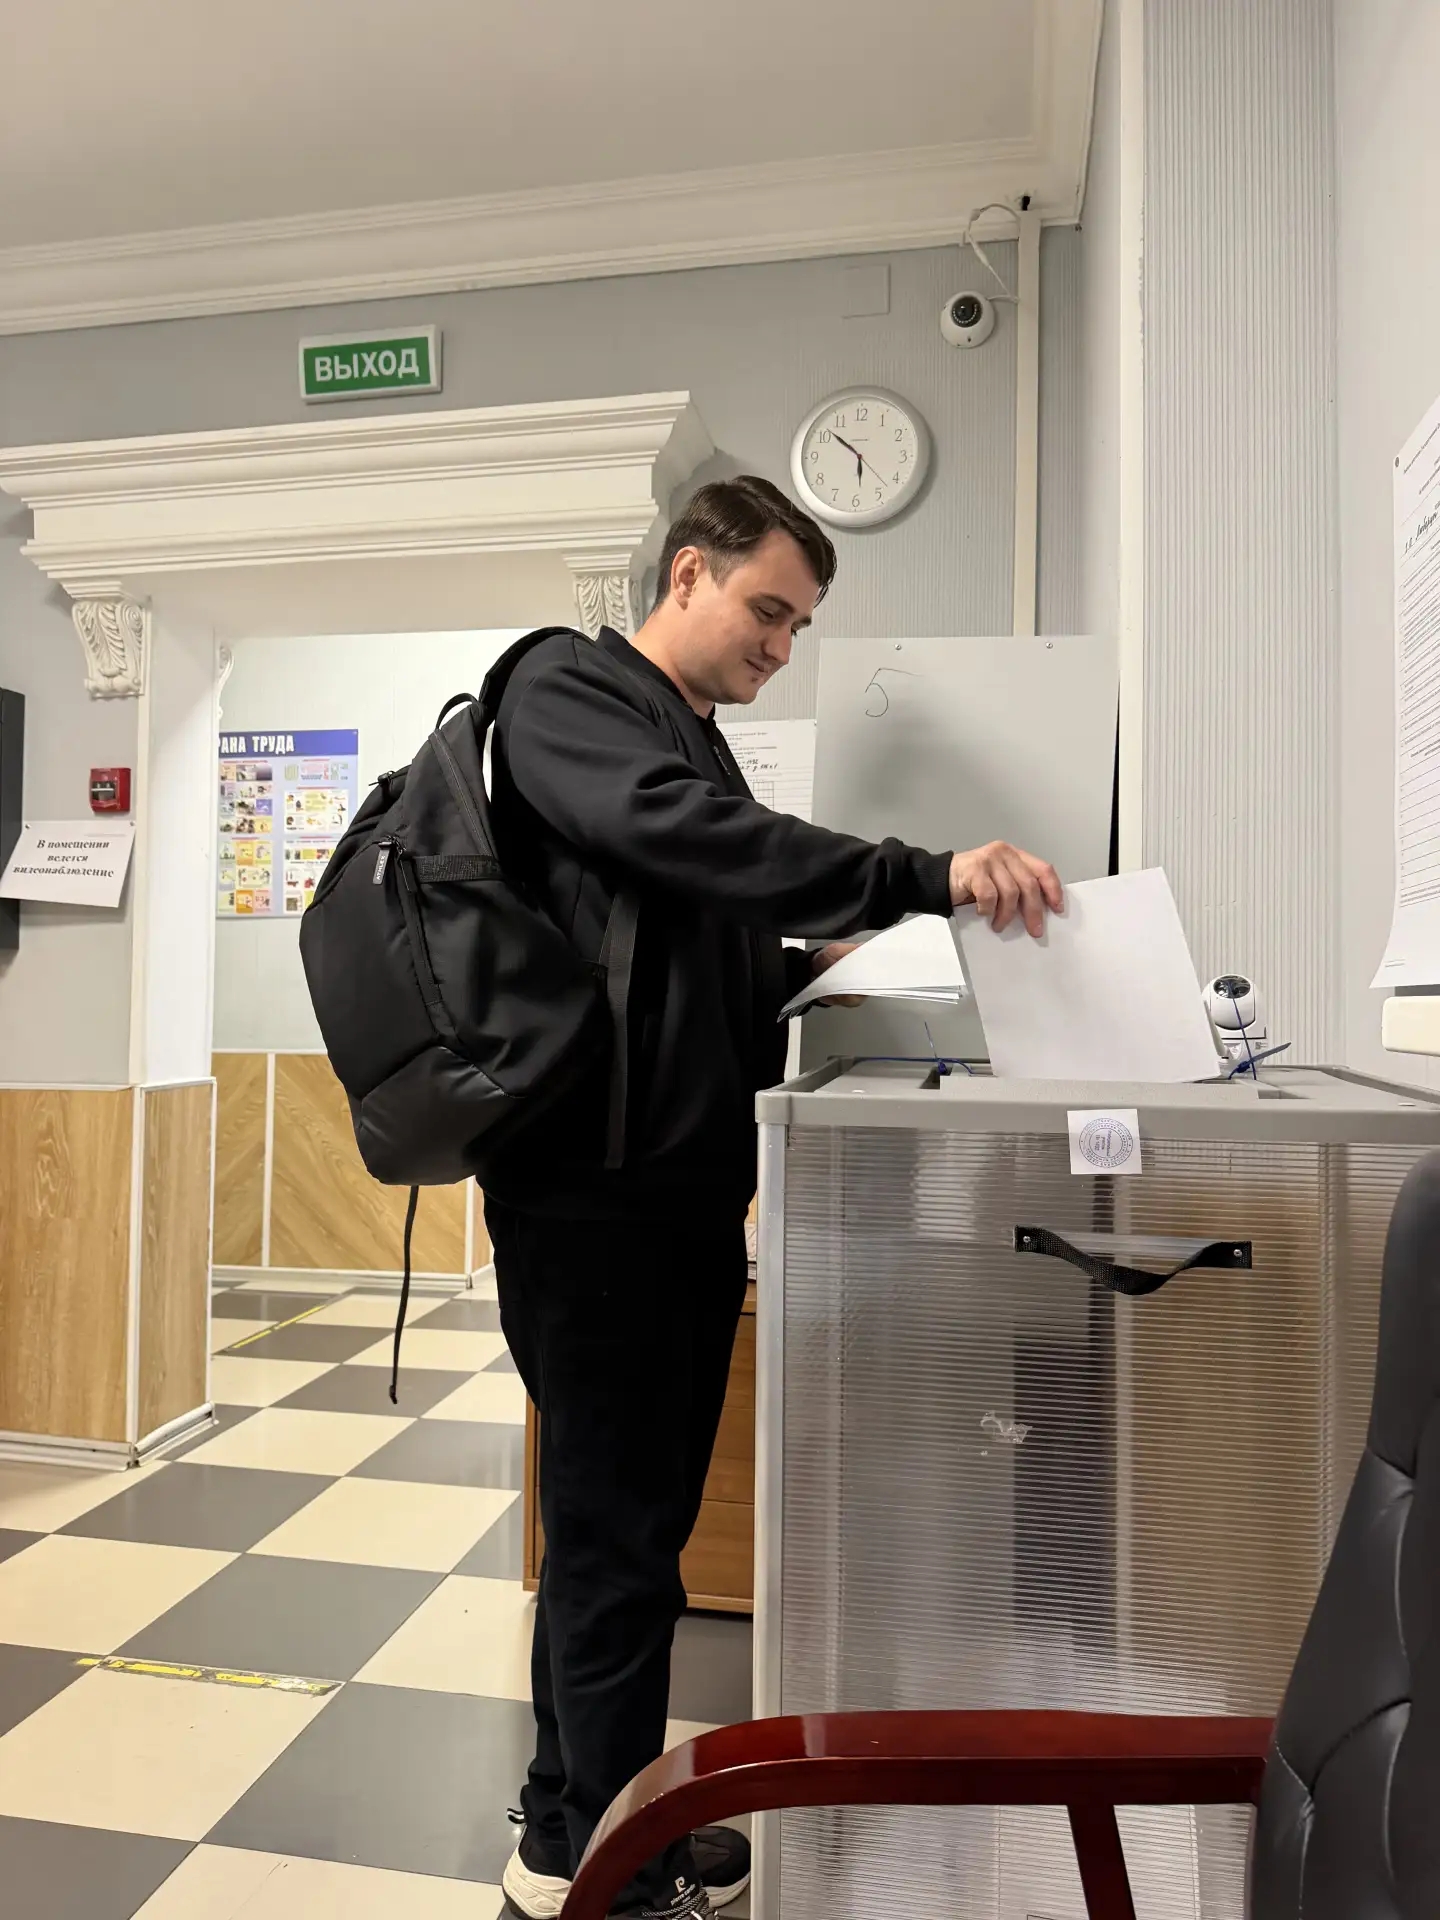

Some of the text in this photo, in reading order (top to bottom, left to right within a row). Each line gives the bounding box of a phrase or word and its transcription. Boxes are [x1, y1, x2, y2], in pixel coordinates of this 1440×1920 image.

[314, 348, 420, 382] ВЫХОД
[835, 414, 846, 428] 11
[855, 408, 868, 421] 12
[879, 414, 885, 427] 1
[817, 429, 831, 443] 10
[894, 429, 903, 442] 2
[810, 451, 819, 464] 9
[899, 450, 908, 464] 3
[816, 472, 824, 485] 8
[892, 471, 900, 484] 4
[831, 488, 839, 501] 7
[851, 494, 860, 507] 6
[874, 487, 882, 501] 5
[865, 667, 924, 718] 5
[218, 735, 295, 755] АНА ТРУДА
[36, 839, 110, 851] В помещении
[13, 866, 115, 878] видеонаблюдение
[376, 855, 386, 881] ATHLEX
